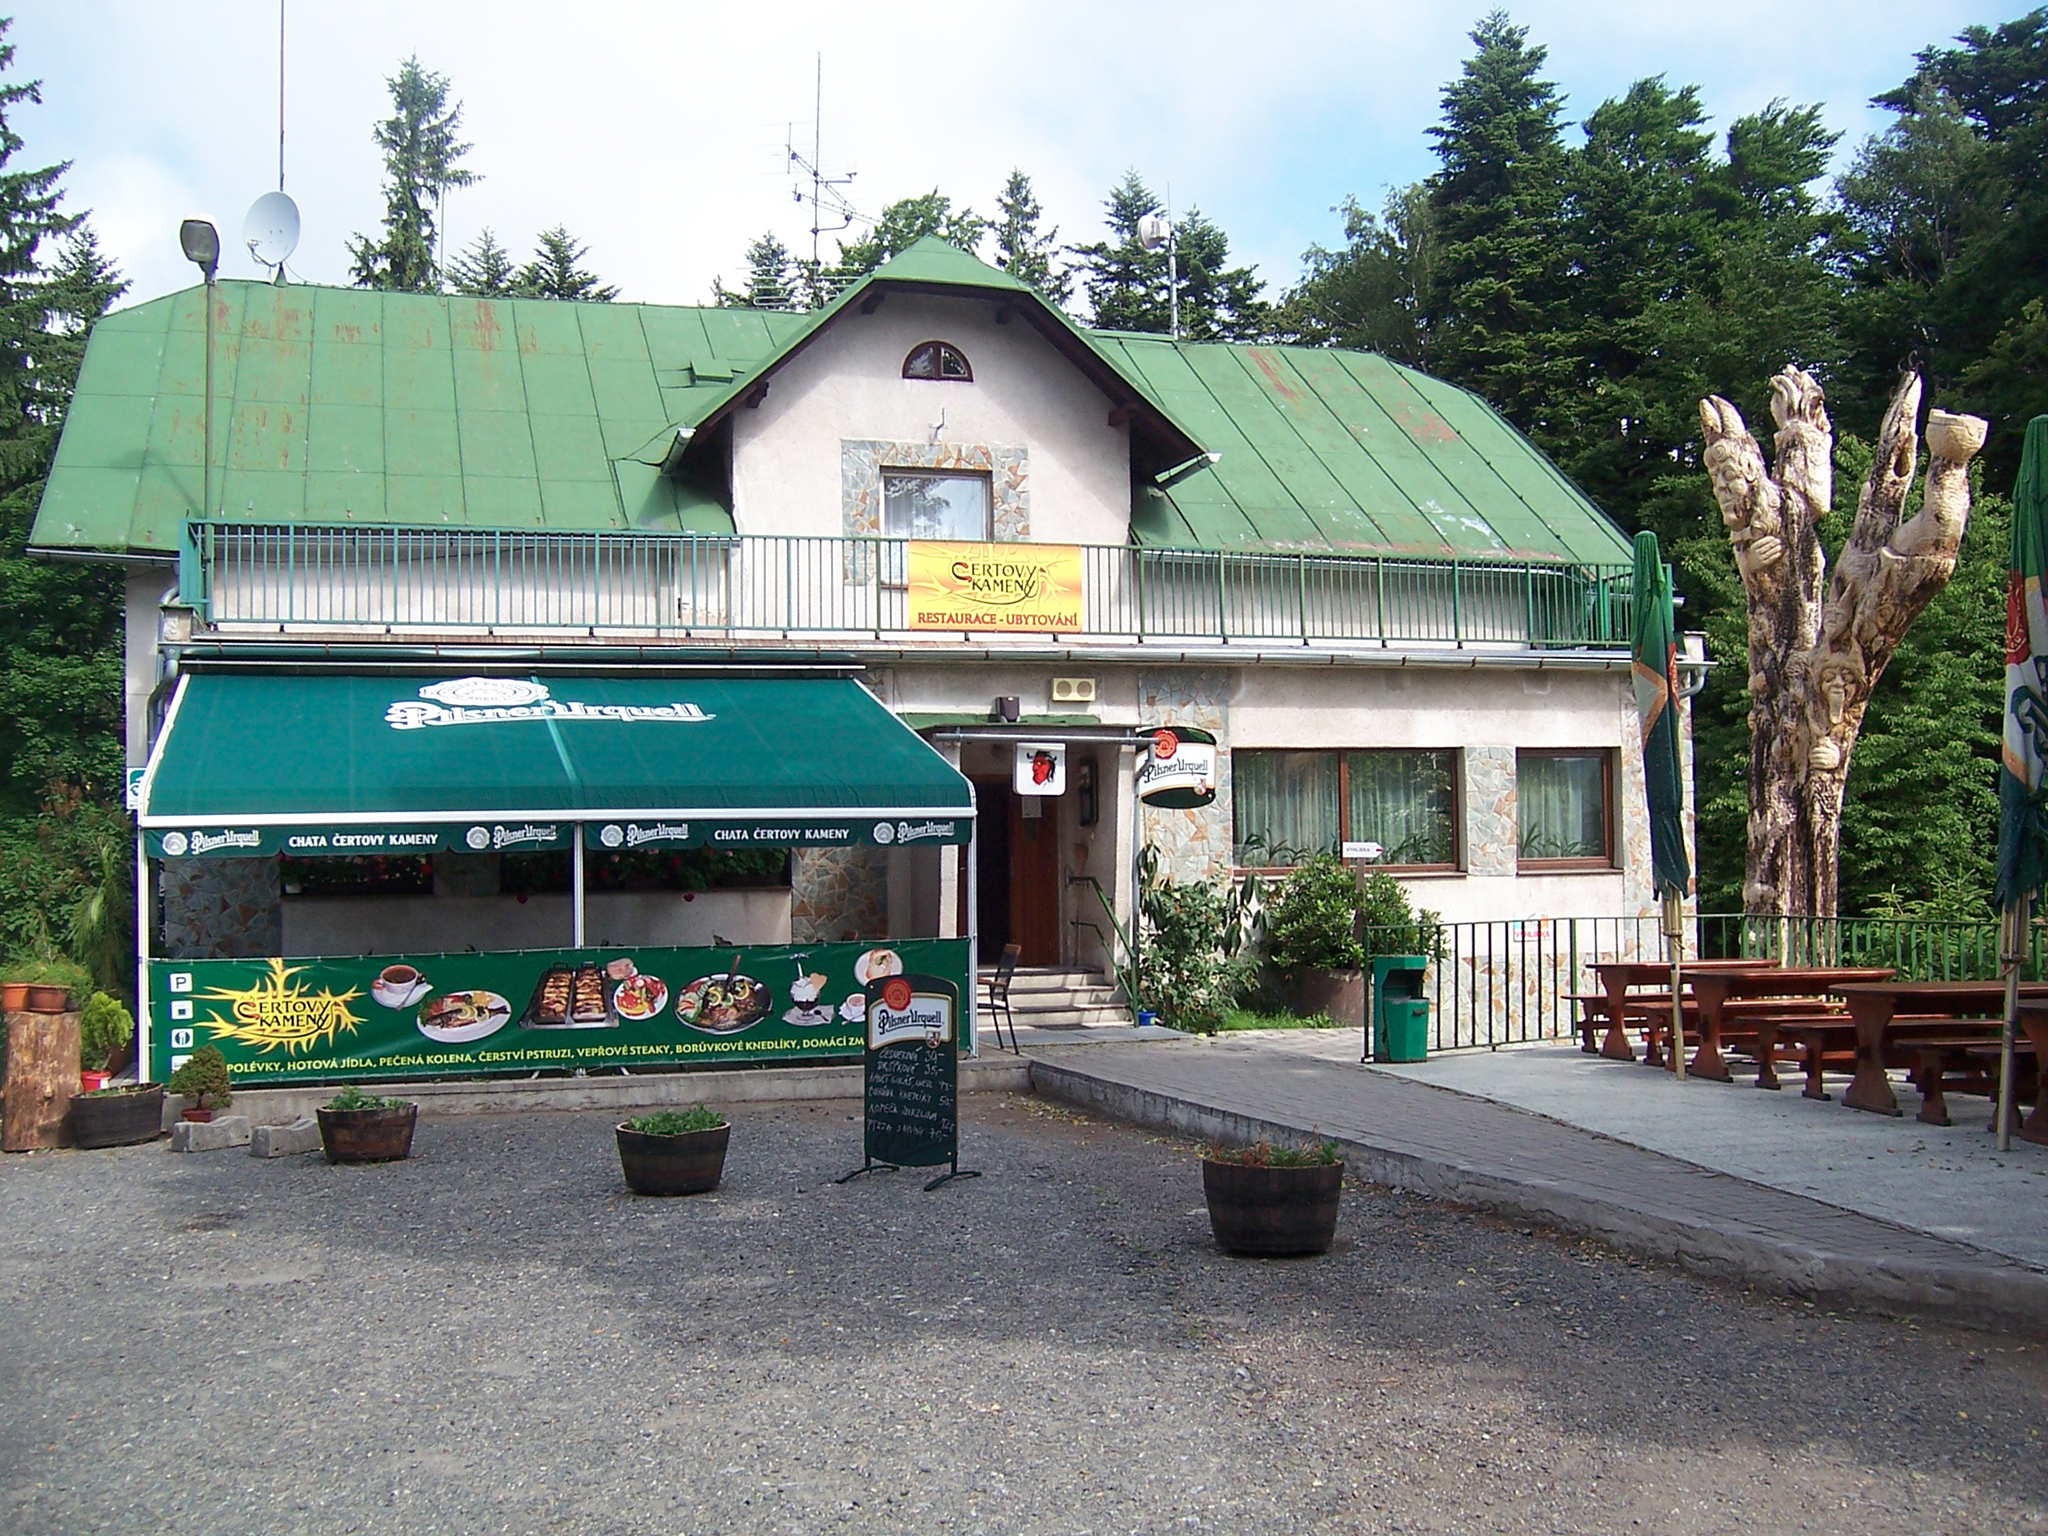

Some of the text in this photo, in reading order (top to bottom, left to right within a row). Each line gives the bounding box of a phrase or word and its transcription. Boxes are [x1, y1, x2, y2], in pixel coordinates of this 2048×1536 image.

[972, 578, 1036, 595] KAMENY
[918, 612, 997, 625] RESTAURACE
[1006, 612, 1078, 627] UBYTOVÁNÍ
[384, 700, 716, 730] Pilsner Urquell
[1143, 757, 1208, 784] Pilsner Urquell
[191, 829, 261, 855] Pilsner Urquell
[288, 833, 439, 848] CHATA ČERTOVY KAMENY
[493, 824, 557, 849] Pilsner Urquell
[626, 822, 689, 847] Pilsner Urquell
[714, 827, 850, 841] CHATA ČERTOVY KAMENY
[897, 820, 955, 844] Pilsner Urquell
[259, 1012, 331, 1030] KAMENY
[878, 1008, 942, 1035] Pilsner Urquell
[226, 1059, 285, 1074] POLÉVKY,
[287, 1056, 338, 1071] HOTOVÁ
[341, 1057, 377, 1069] JÍDLA,
[379, 1054, 425, 1067] PEČENÁ
[426, 1053, 477, 1064] KOLENA,
[478, 1049, 524, 1062] ČERSTVÍ
[526, 1048, 575, 1060] PSTRUZI,
[577, 1044, 629, 1057] VEPŘOVÉ
[629, 1044, 673, 1056] STEAKY,
[676, 1040, 744, 1054] BORŮVKOVÉ
[745, 1038, 801, 1050] KNEDLÍKY,
[803, 1035, 847, 1049] DOMÁCÍ
